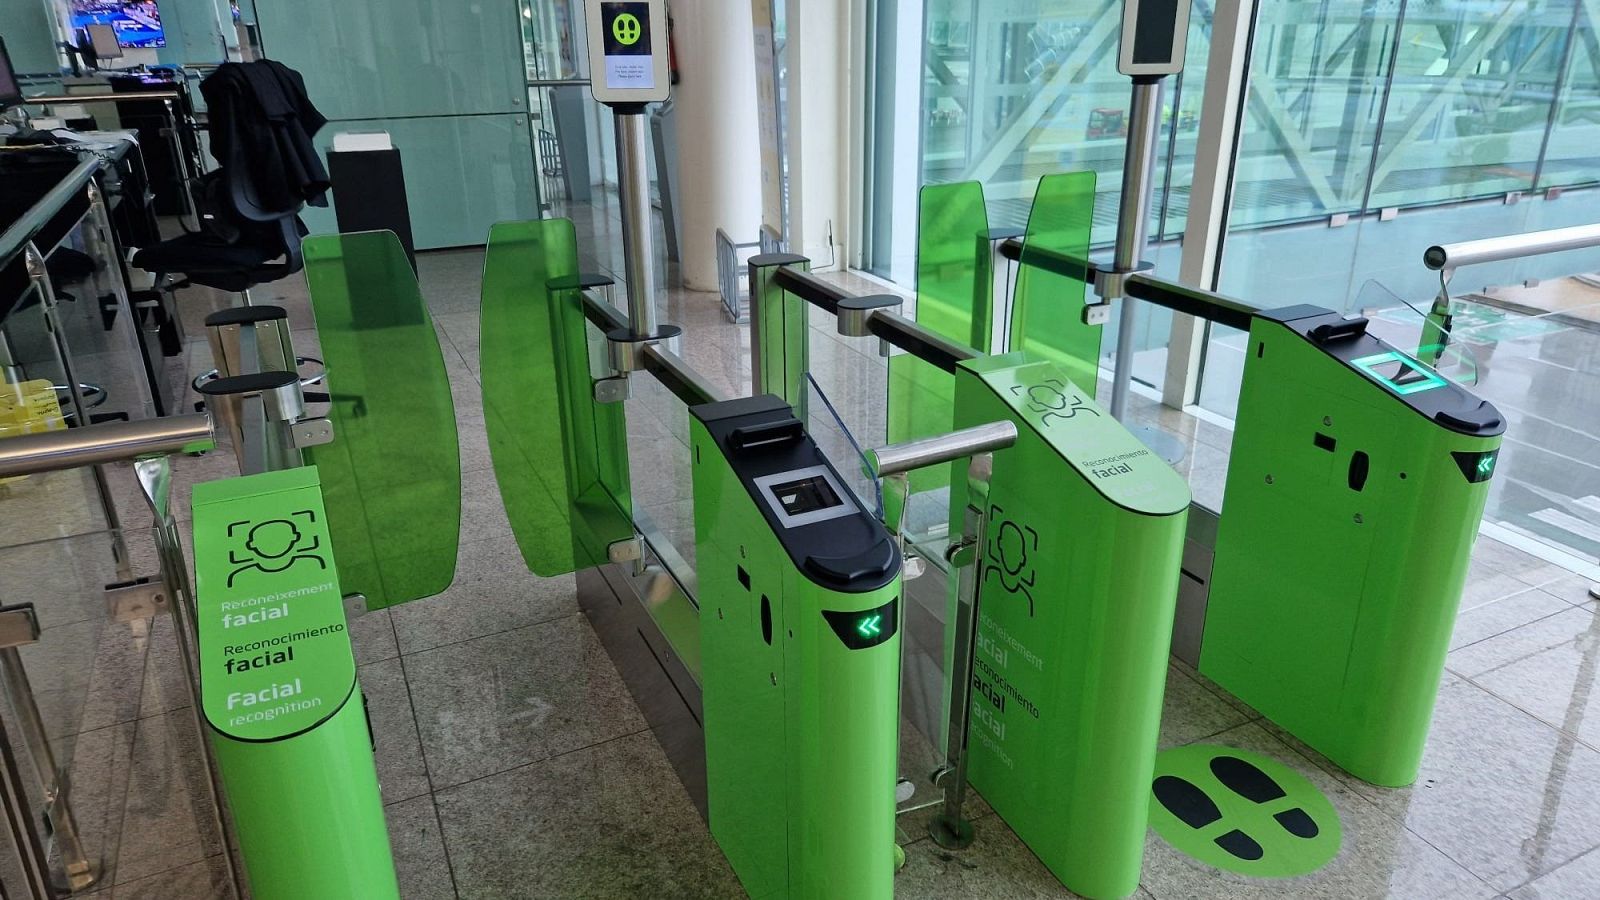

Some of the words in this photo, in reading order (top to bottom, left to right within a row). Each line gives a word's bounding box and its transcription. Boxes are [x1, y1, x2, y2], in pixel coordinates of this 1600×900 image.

[1081, 448, 1148, 467] Reconocimiento
[1091, 462, 1133, 479] facial
[221, 582, 334, 612] Reconeixement
[221, 602, 289, 629] facial
[223, 623, 344, 656] Reconocimiento
[977, 631, 1008, 669] acial
[223, 646, 294, 675] facial
[226, 678, 302, 710] Facial
[974, 673, 1006, 714] acial
[975, 655, 1040, 720] econocimiento
[229, 697, 321, 727] recognition
[973, 701, 1006, 741] acial
